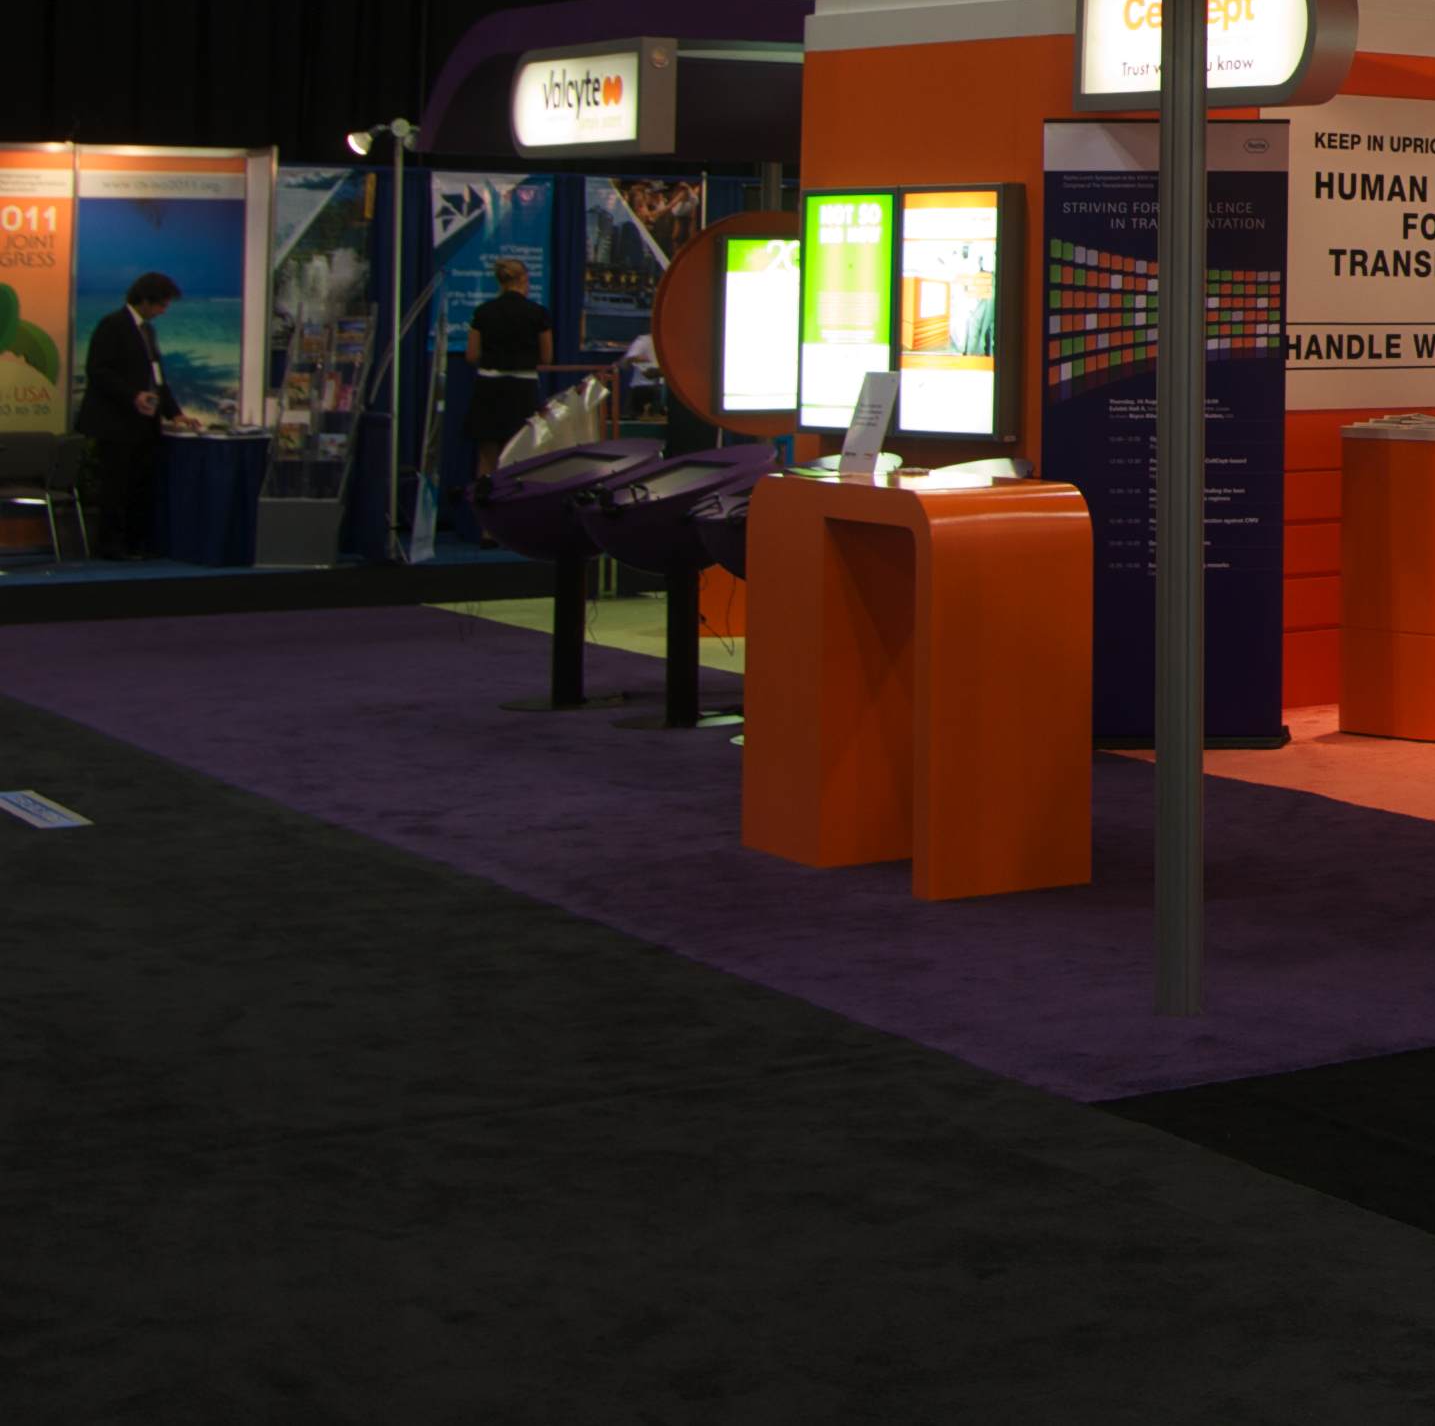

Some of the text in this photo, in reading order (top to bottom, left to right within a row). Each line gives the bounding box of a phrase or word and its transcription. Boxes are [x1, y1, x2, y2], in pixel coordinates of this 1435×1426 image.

[1122, 61, 1149, 77] Trust
[1217, 55, 1254, 72] know
[543, 68, 601, 120] Valcyte
[1314, 131, 1361, 152] KEEP
[1367, 134, 1385, 153] IN
[1313, 171, 1428, 203] HUMAN
[1062, 201, 1253, 214] STRIVING FOR LENCE
[1110, 217, 1126, 230] IN
[1285, 333, 1402, 362] HANDLE
